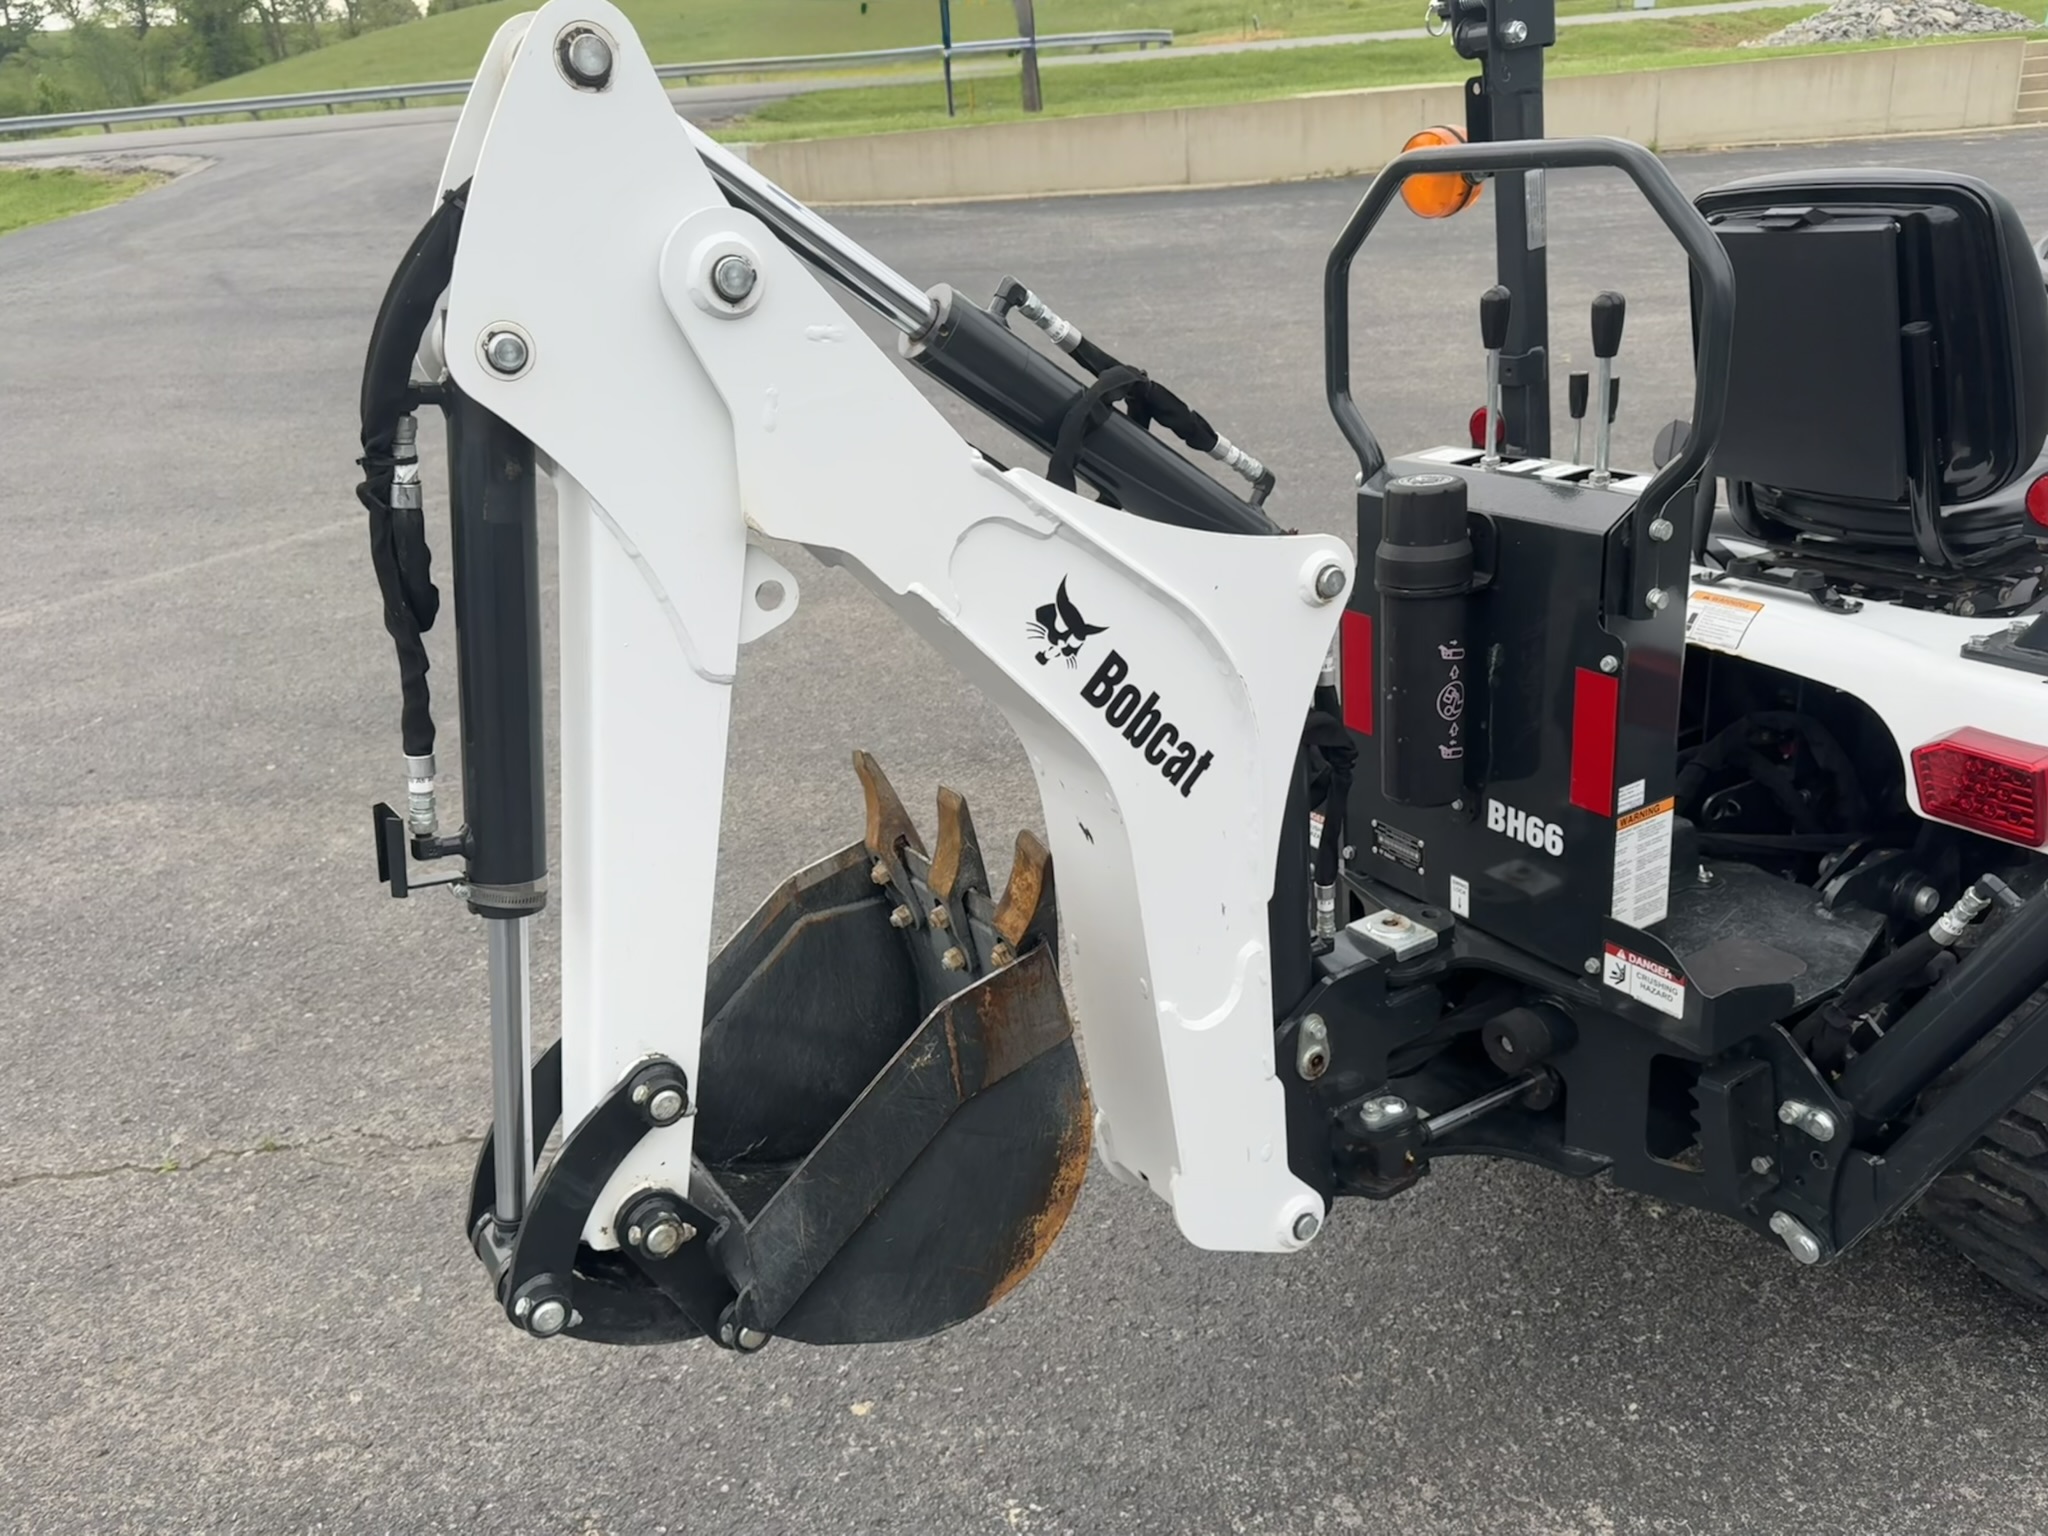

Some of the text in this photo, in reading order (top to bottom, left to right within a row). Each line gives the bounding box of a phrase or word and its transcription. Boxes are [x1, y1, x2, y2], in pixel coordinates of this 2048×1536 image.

[1080, 649, 1214, 798] Bobcat
[1487, 798, 1564, 856] BH66
[1620, 804, 1660, 826] WARNING
[1636, 971, 1678, 996] CRUSHING
[1640, 982, 1674, 1003] HAZARD
